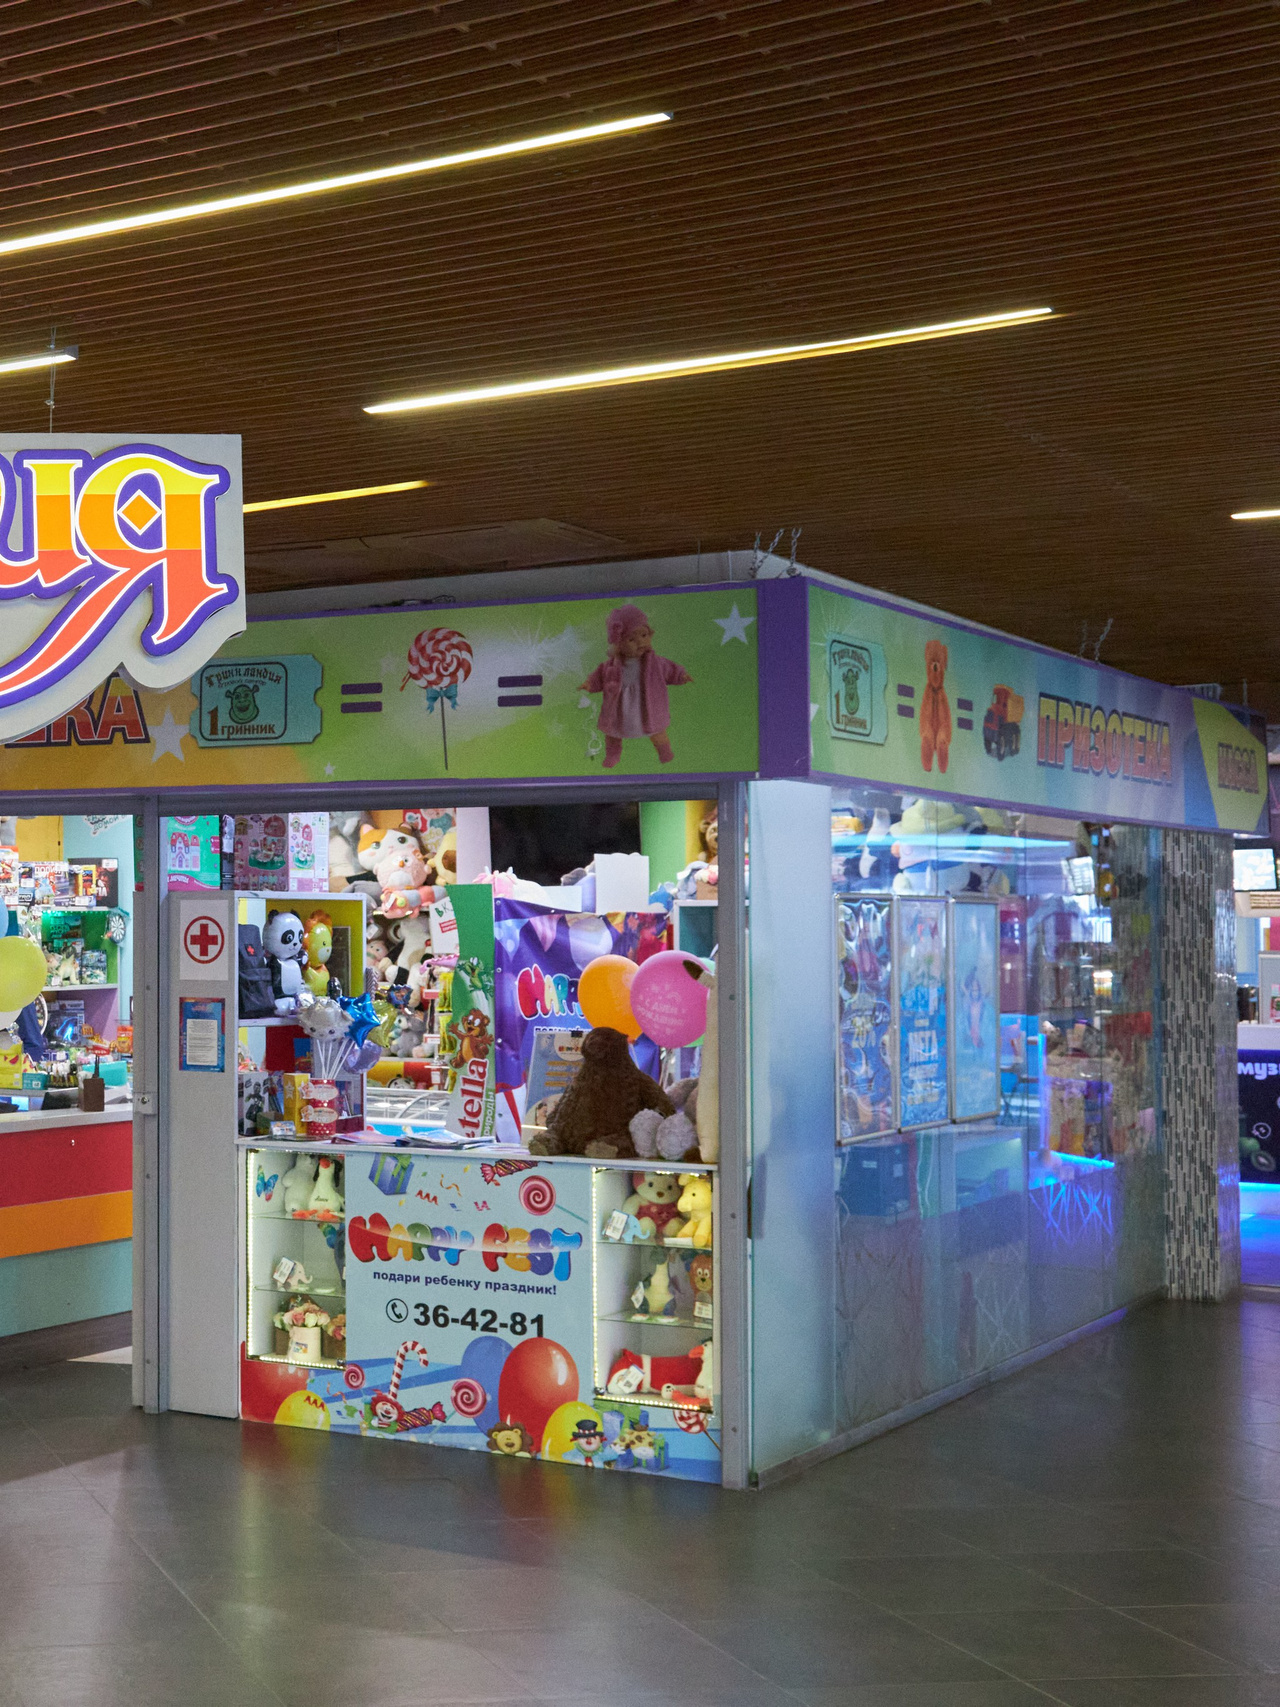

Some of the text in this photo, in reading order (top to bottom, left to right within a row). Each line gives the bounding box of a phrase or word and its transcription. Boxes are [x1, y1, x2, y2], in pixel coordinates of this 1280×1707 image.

[207, 705, 275, 740] 1 гринник
[1036, 691, 1173, 788] ПРИЗОТЕКА
[516, 963, 583, 1020] HAPP
[1238, 1062, 1280, 1080] муз
[348, 1213, 582, 1281] HAPPY FEST
[373, 1271, 557, 1296] подари ребенку праздник!
[413, 1302, 545, 1338] 36-42-81
